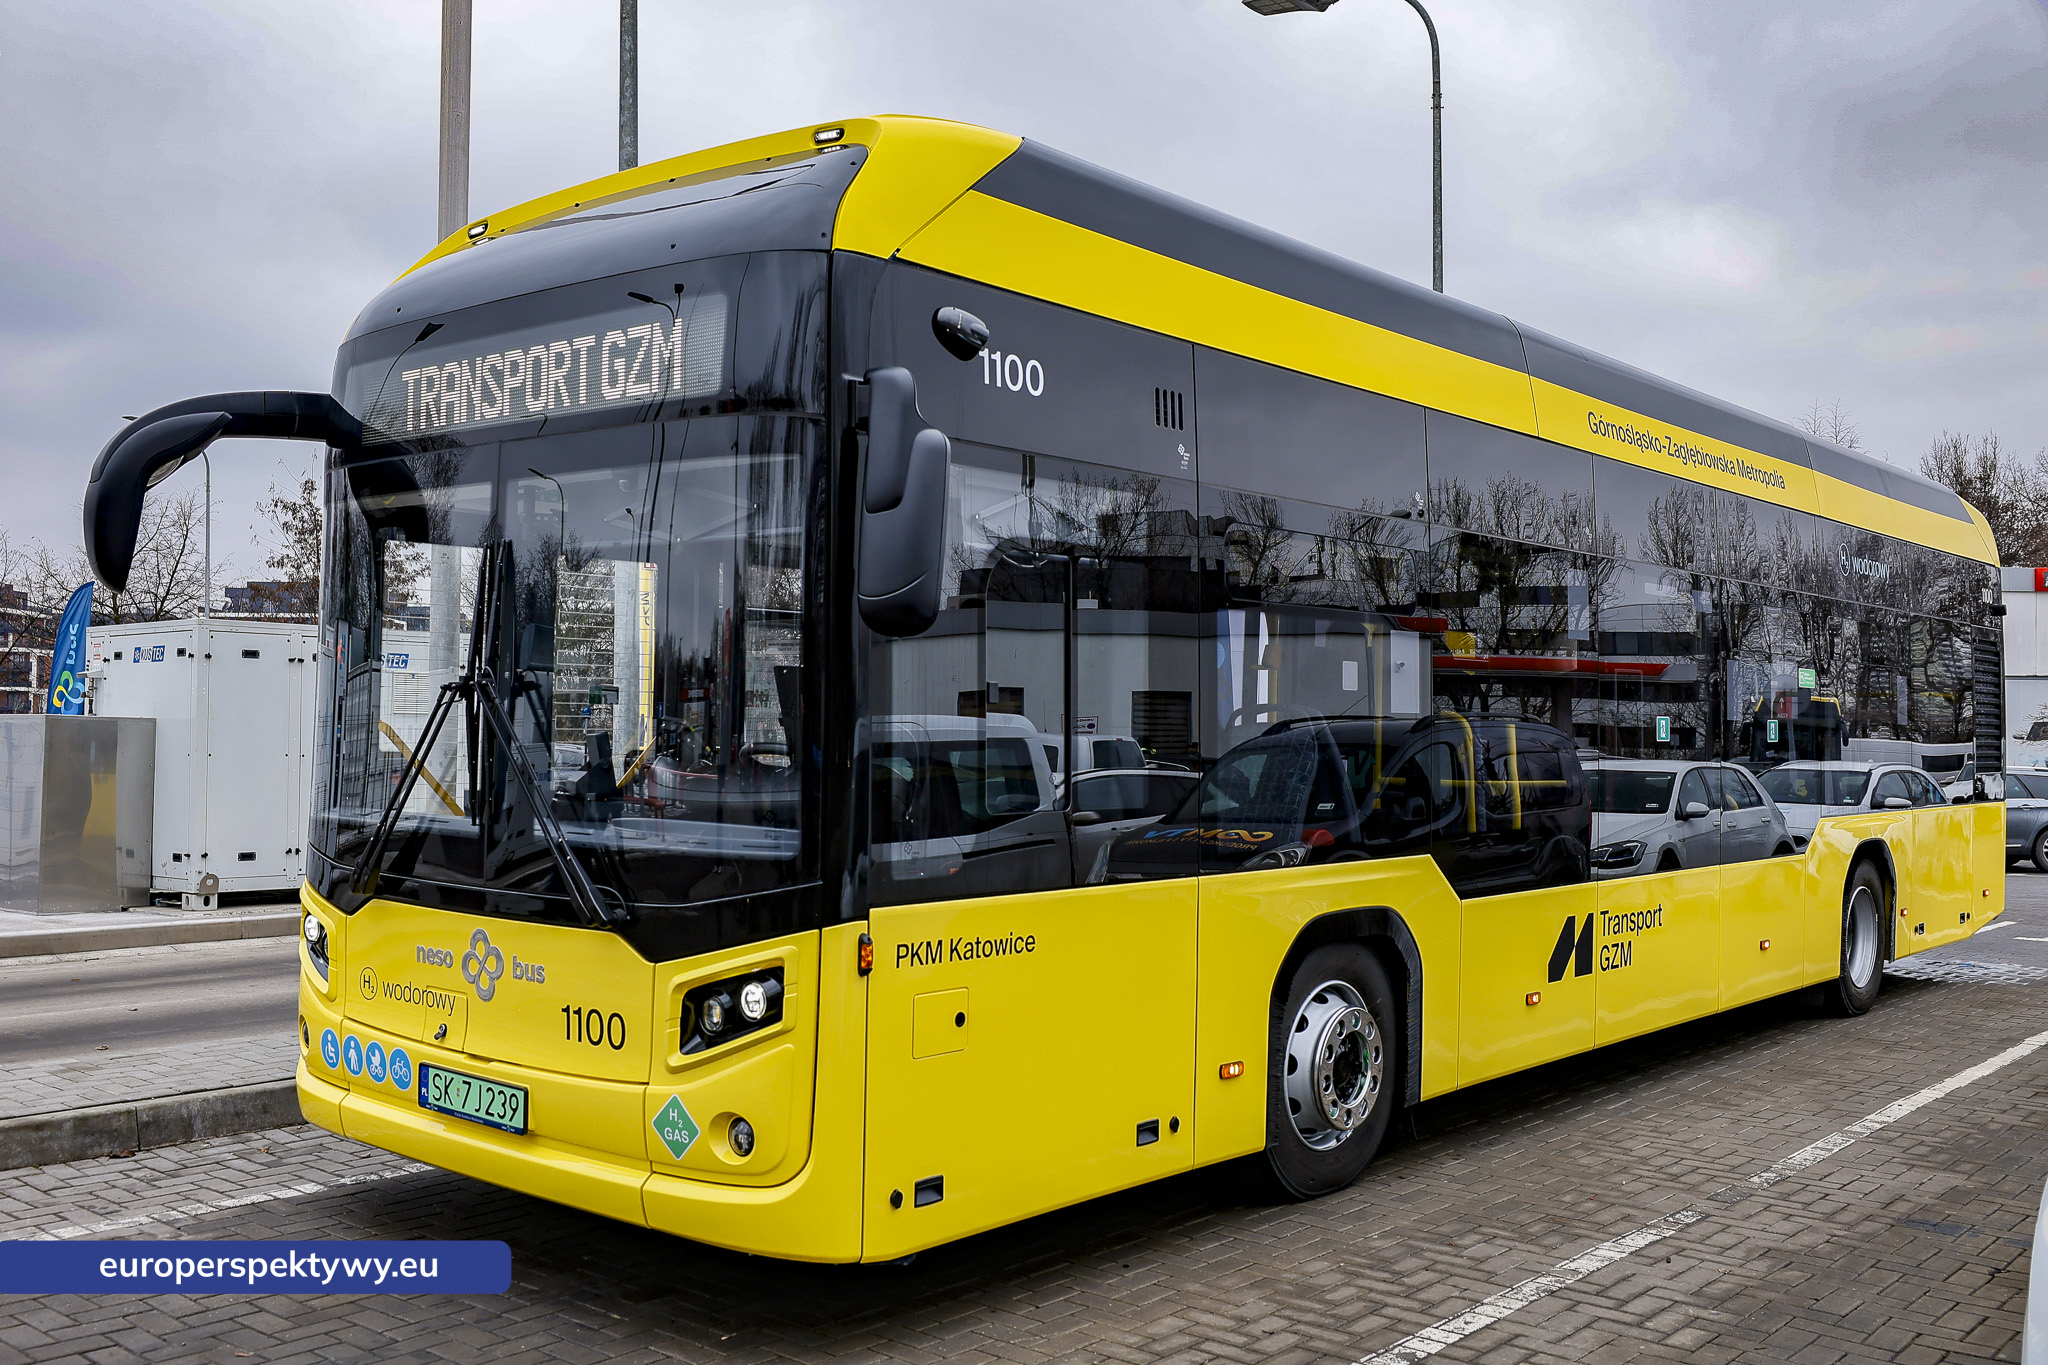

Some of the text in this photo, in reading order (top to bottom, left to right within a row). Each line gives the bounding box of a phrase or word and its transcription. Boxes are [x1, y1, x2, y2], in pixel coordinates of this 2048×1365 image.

[401, 318, 683, 432] TRANSPORT GZM
[978, 348, 1045, 397] 1100
[1587, 411, 1786, 490] Górnośląsko-Zagłębiowska Metropolia
[1852, 554, 1890, 584] wodorowy
[1600, 904, 1662, 936] Transport
[416, 945, 545, 984] neso bus
[896, 932, 1036, 969] PKM Katowice
[1600, 941, 1632, 971] GZM
[382, 981, 456, 1016] wodorowy
[561, 1004, 626, 1050] 1100
[421, 1087, 428, 1096] PL
[432, 1073, 519, 1122] SK 7J239
[664, 1127, 689, 1143] GAS
